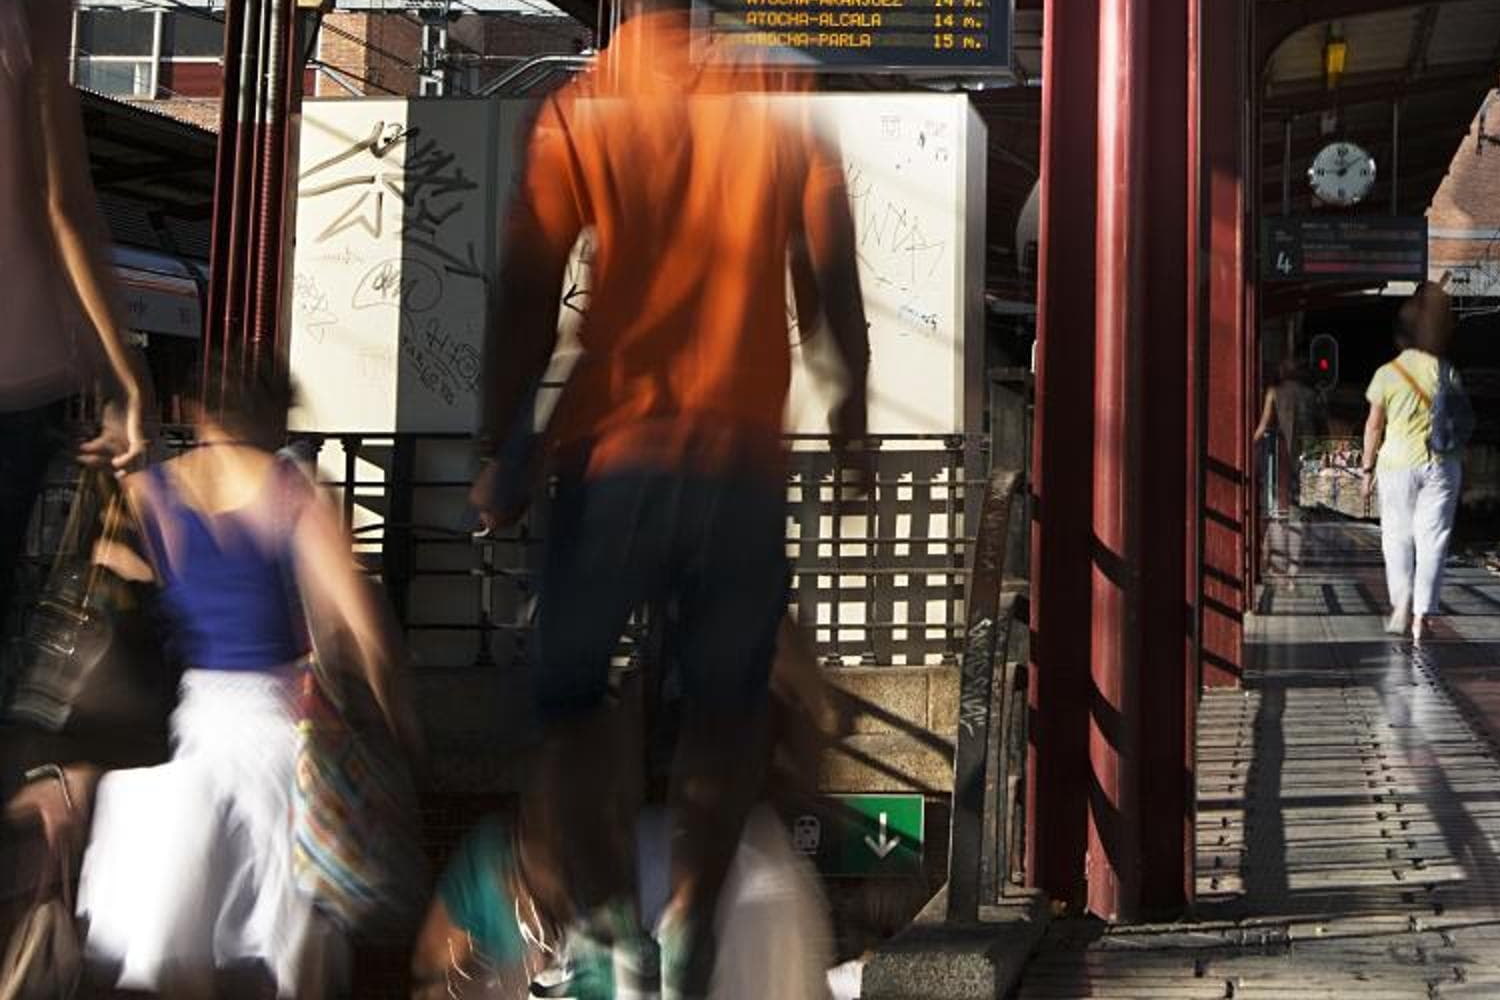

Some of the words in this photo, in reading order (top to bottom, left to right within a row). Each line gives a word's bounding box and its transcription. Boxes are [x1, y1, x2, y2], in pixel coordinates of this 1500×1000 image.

[745, 12, 882, 27] ATOCHA-ALCALA
[934, 13, 955, 28] 14
[934, 32, 954, 50] 15
[1276, 251, 1292, 274] 4
